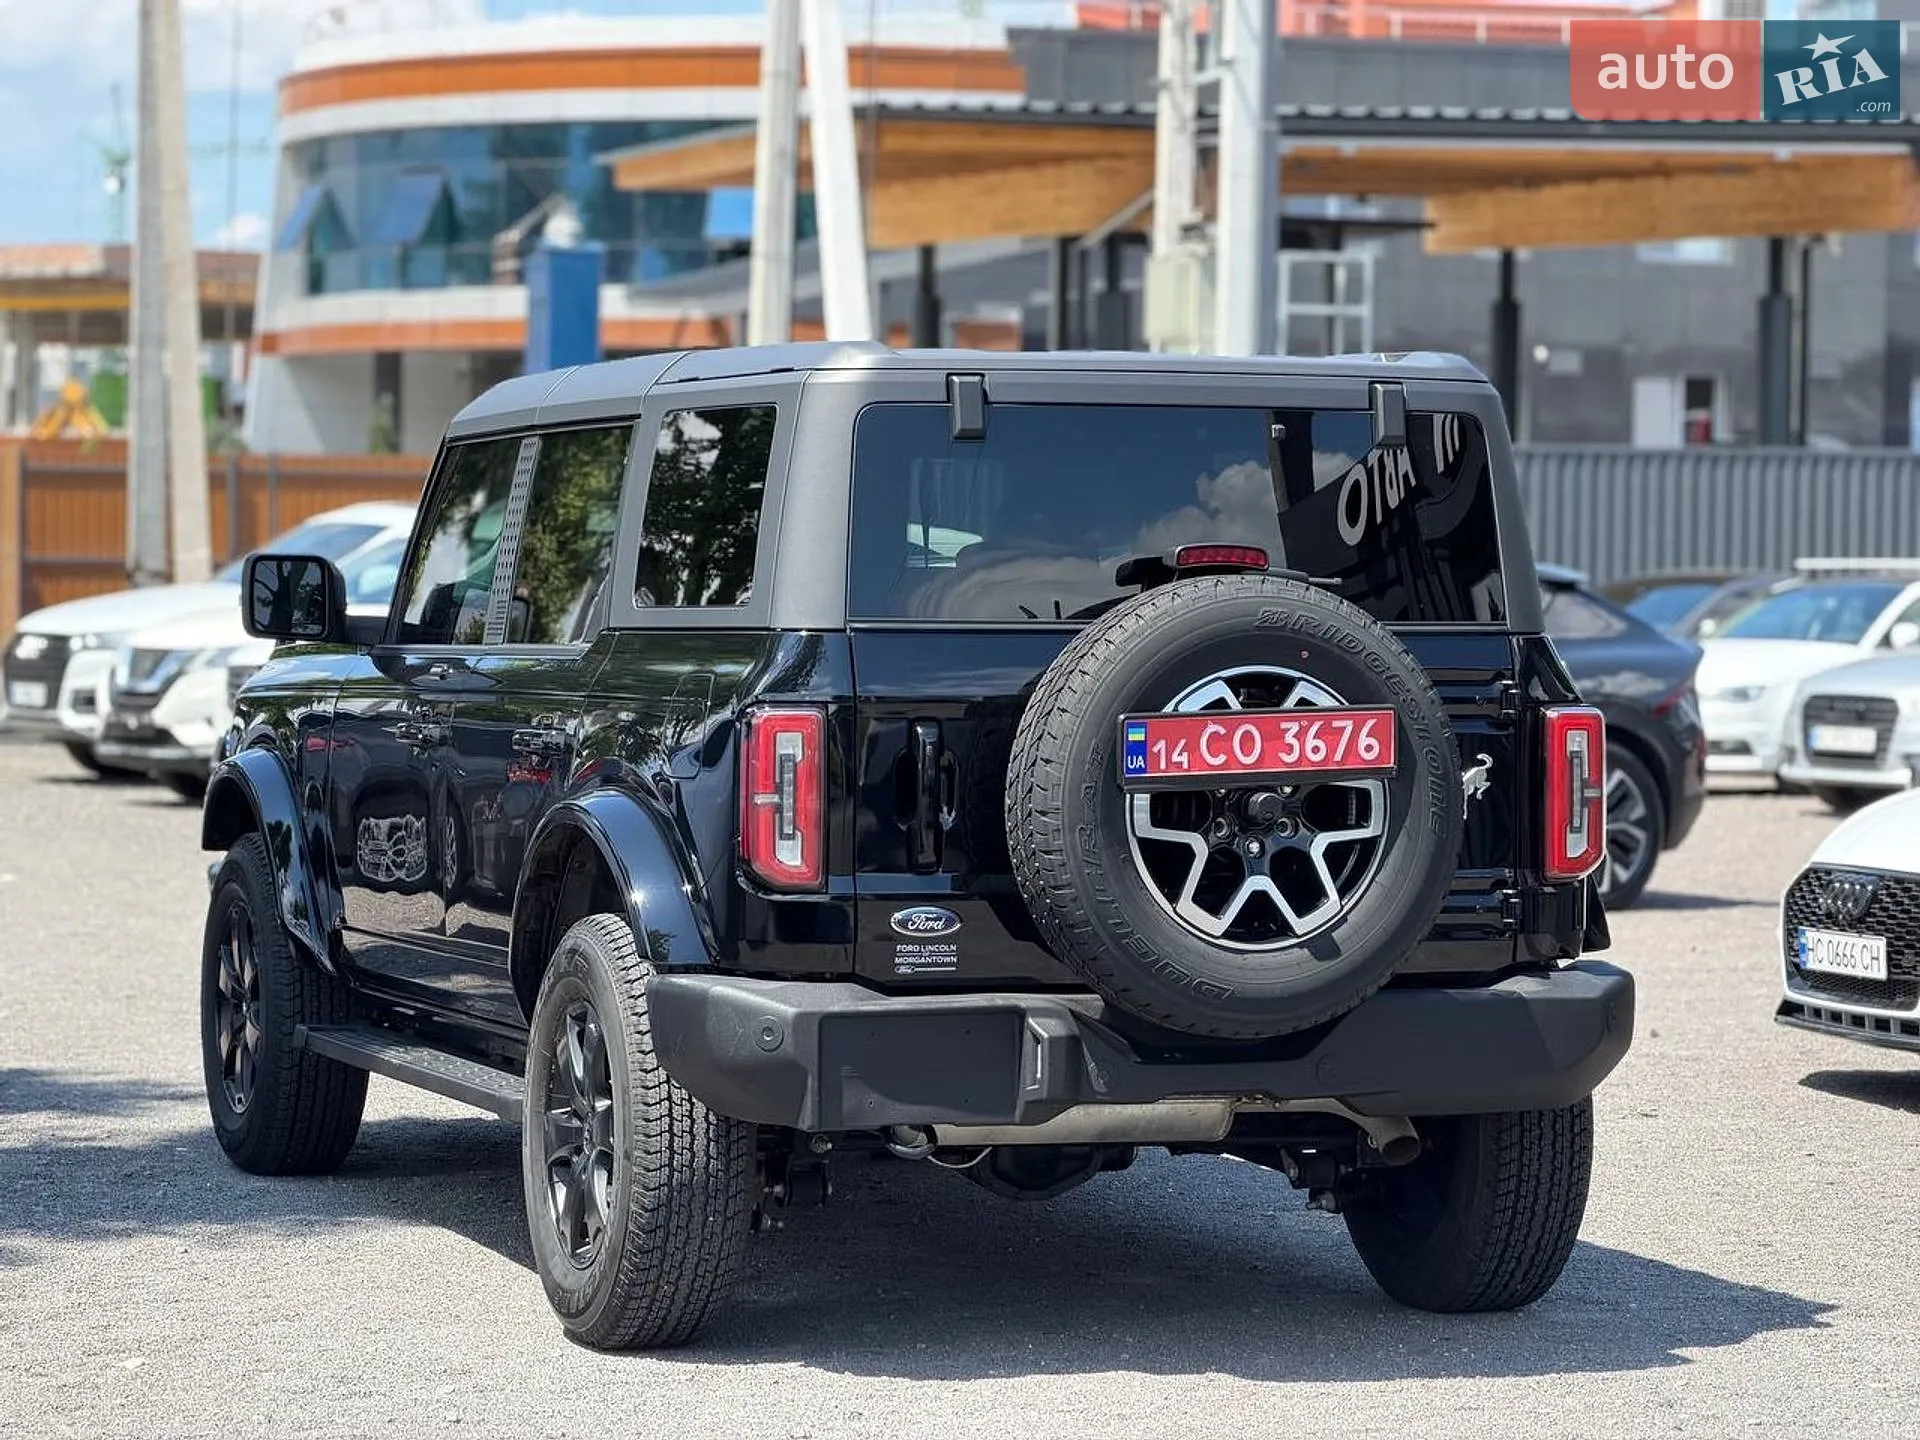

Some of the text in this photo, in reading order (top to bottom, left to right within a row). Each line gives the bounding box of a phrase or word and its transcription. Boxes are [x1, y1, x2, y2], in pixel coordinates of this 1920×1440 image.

[1253, 608, 1447, 837] BRIDGESTONE
[1152, 718, 1381, 770] 14 CO 3676
[1128, 756, 1145, 769] UA
[907, 913, 946, 930] Ford
[896, 944, 957, 952] FORD LINCOLN
[1827, 939, 1857, 969] 0666
[1860, 943, 1881, 973] CH
[895, 956, 957, 964] MORGANTOWN
